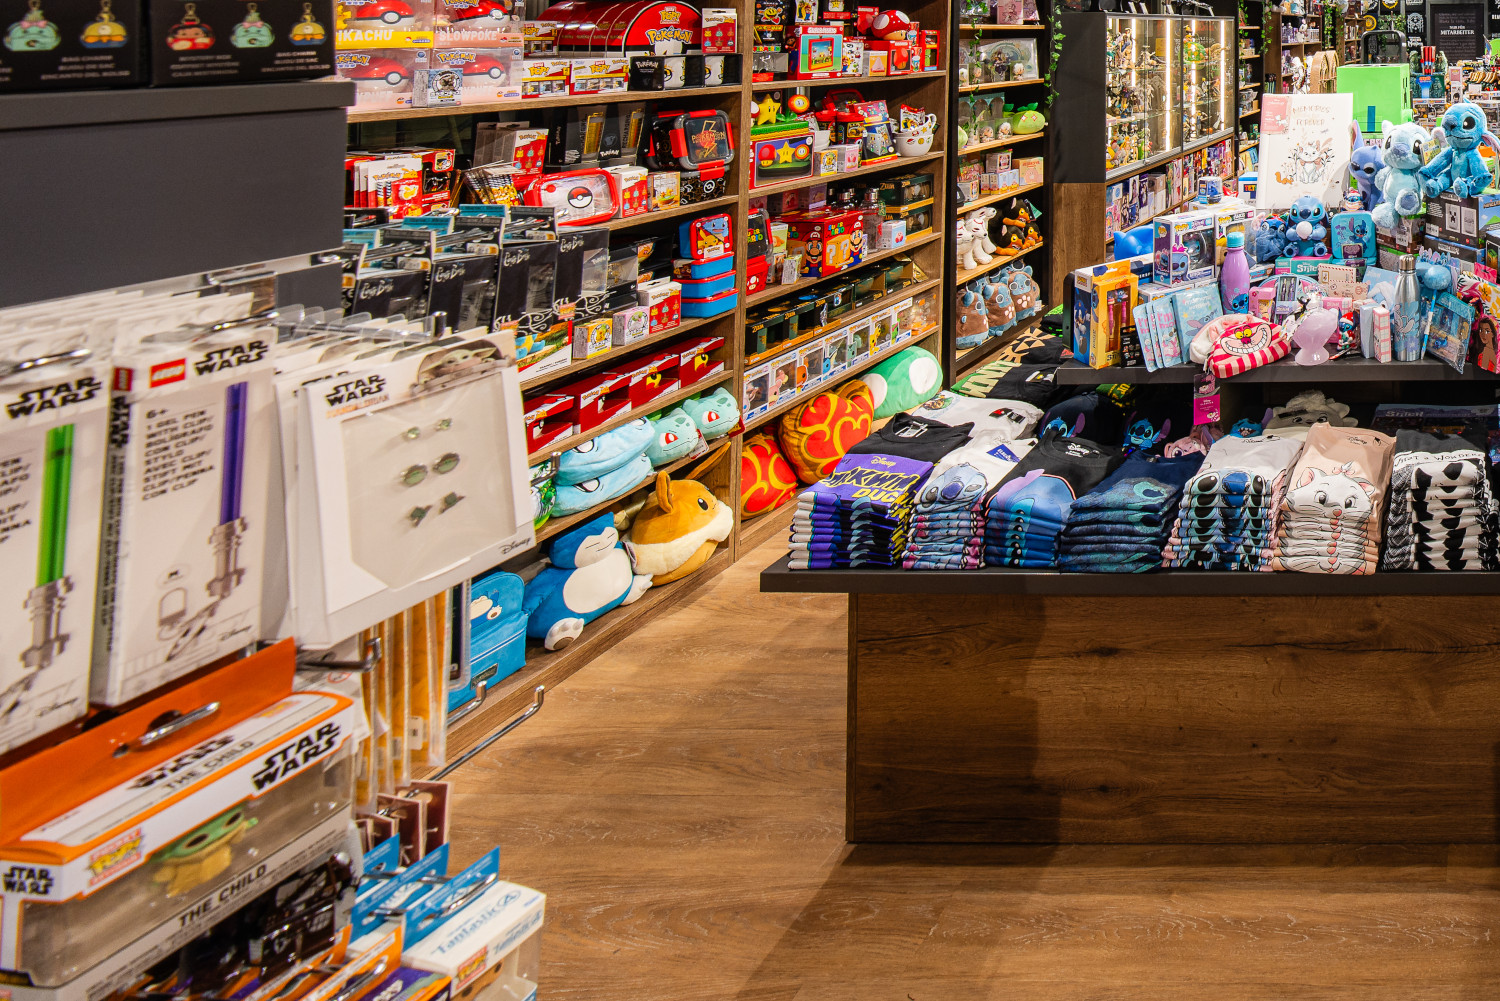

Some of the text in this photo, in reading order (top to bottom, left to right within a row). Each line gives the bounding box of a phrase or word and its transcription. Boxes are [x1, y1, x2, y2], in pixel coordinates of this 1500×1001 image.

[338, 30, 393, 42] IKACHU
[438, 31, 497, 42] SLOWPOKE
[1297, 263, 1318, 273] STITC
[202, 340, 268, 364] STAR
[193, 350, 268, 376] WARS
[151, 363, 186, 383] LEGO
[19, 376, 102, 401] STAR
[325, 382, 386, 407] WARS
[5, 386, 102, 419] WARS
[182, 410, 206, 421] PEN
[145, 426, 178, 440] WITH
[144, 449, 185, 466] STYLO
[1067, 443, 1089, 455] Disney
[143, 461, 178, 474] AVEC
[871, 456, 897, 467] Disney
[143, 459, 202, 483] STIFT MIT
[142, 489, 167, 501] CON
[252, 722, 340, 779] STAR
[164, 770, 198, 790] THE
[203, 740, 254, 769] CHILD
[178, 864, 267, 927] THE CHILD
